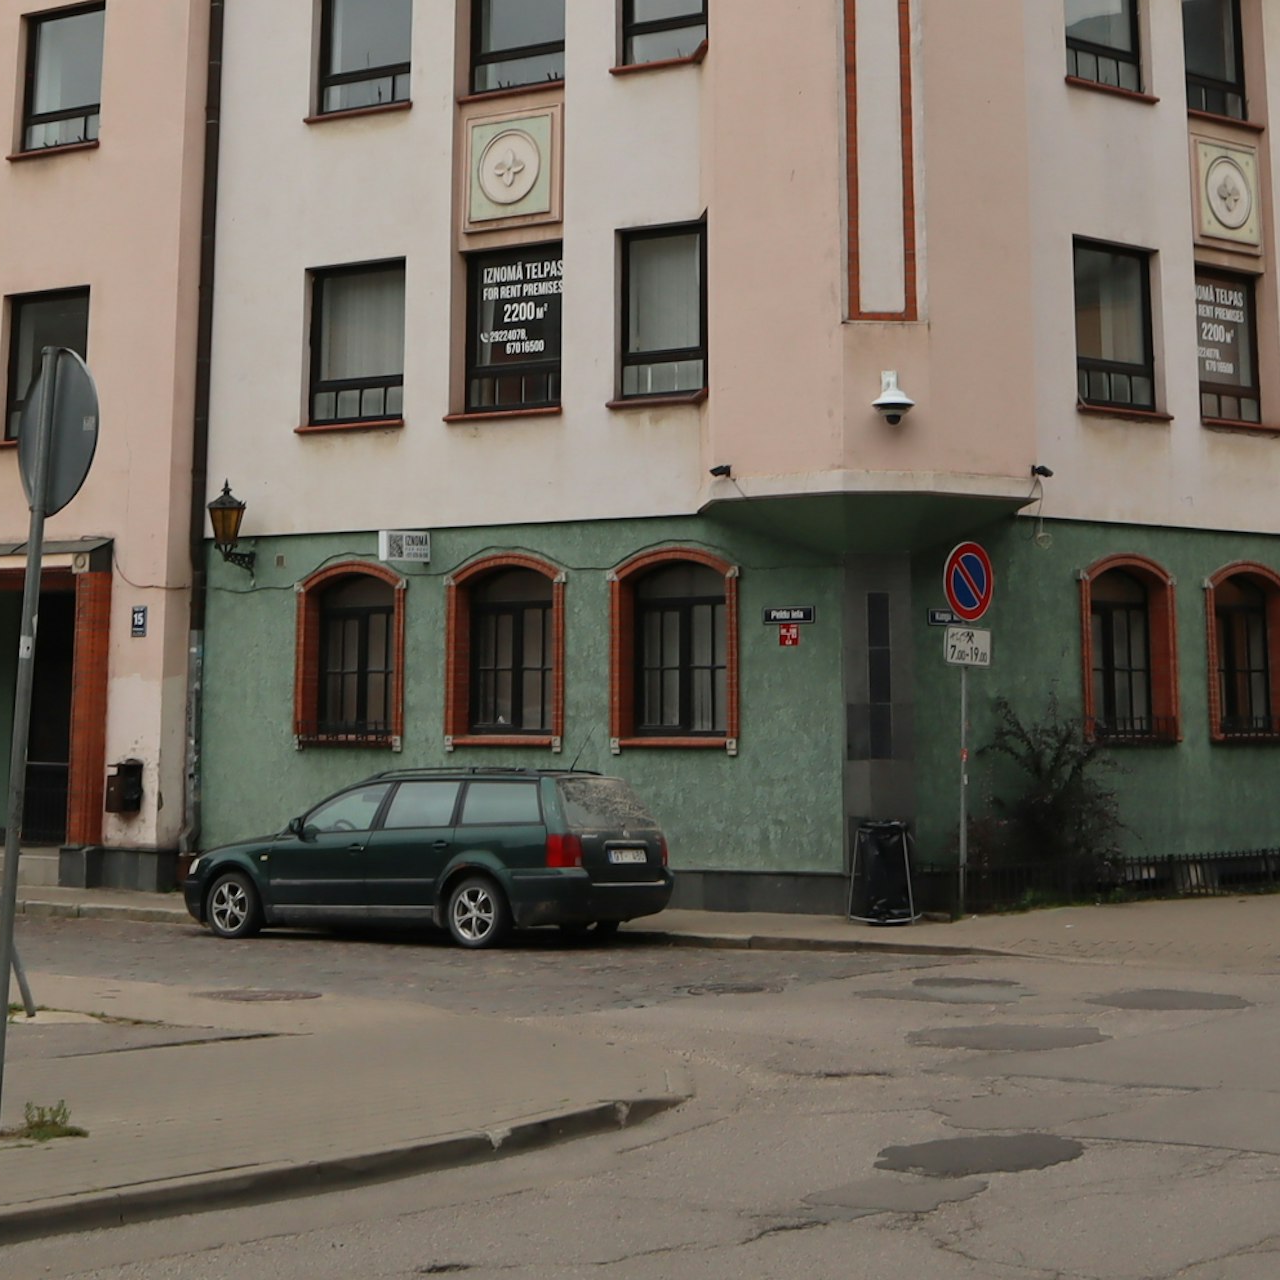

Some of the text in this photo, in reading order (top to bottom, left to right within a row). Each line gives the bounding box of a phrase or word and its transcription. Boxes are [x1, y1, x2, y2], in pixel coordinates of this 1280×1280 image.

[483, 259, 563, 284] IZNOMĀ TELPAS
[483, 280, 563, 301] FOR RENT PREMISES
[1195, 284, 1243, 307] OMĀ TELPAS
[503, 301, 535, 323] 2200
[1201, 322, 1225, 343] 2200
[405, 534, 428, 546] IZNOMĀ
[133, 612, 144, 626] 15
